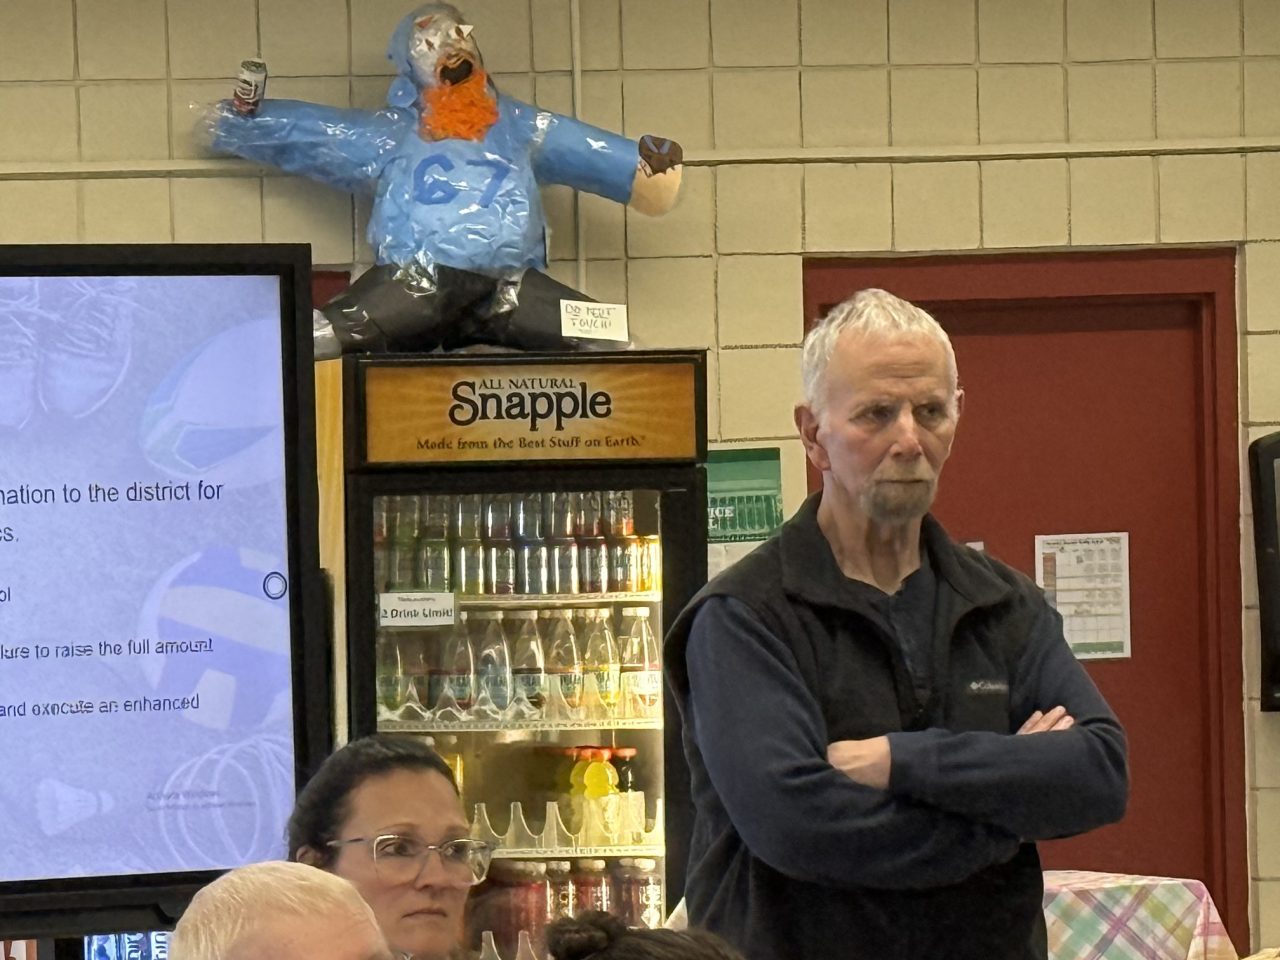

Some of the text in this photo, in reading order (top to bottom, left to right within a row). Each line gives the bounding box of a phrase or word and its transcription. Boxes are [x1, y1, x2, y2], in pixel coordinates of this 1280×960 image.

[478, 377, 577, 390] ALL NATURAL
[448, 380, 612, 432] Snapple
[549, 435, 582, 449] Stuff
[62, 483, 82, 504] to
[87, 483, 120, 503] the
[125, 479, 192, 502] district
[197, 479, 225, 501] for
[34, 644, 50, 660] to
[55, 644, 94, 659] raise
[98, 640, 123, 657] the
[127, 638, 150, 656] full
[123, 692, 200, 712] enhanced
